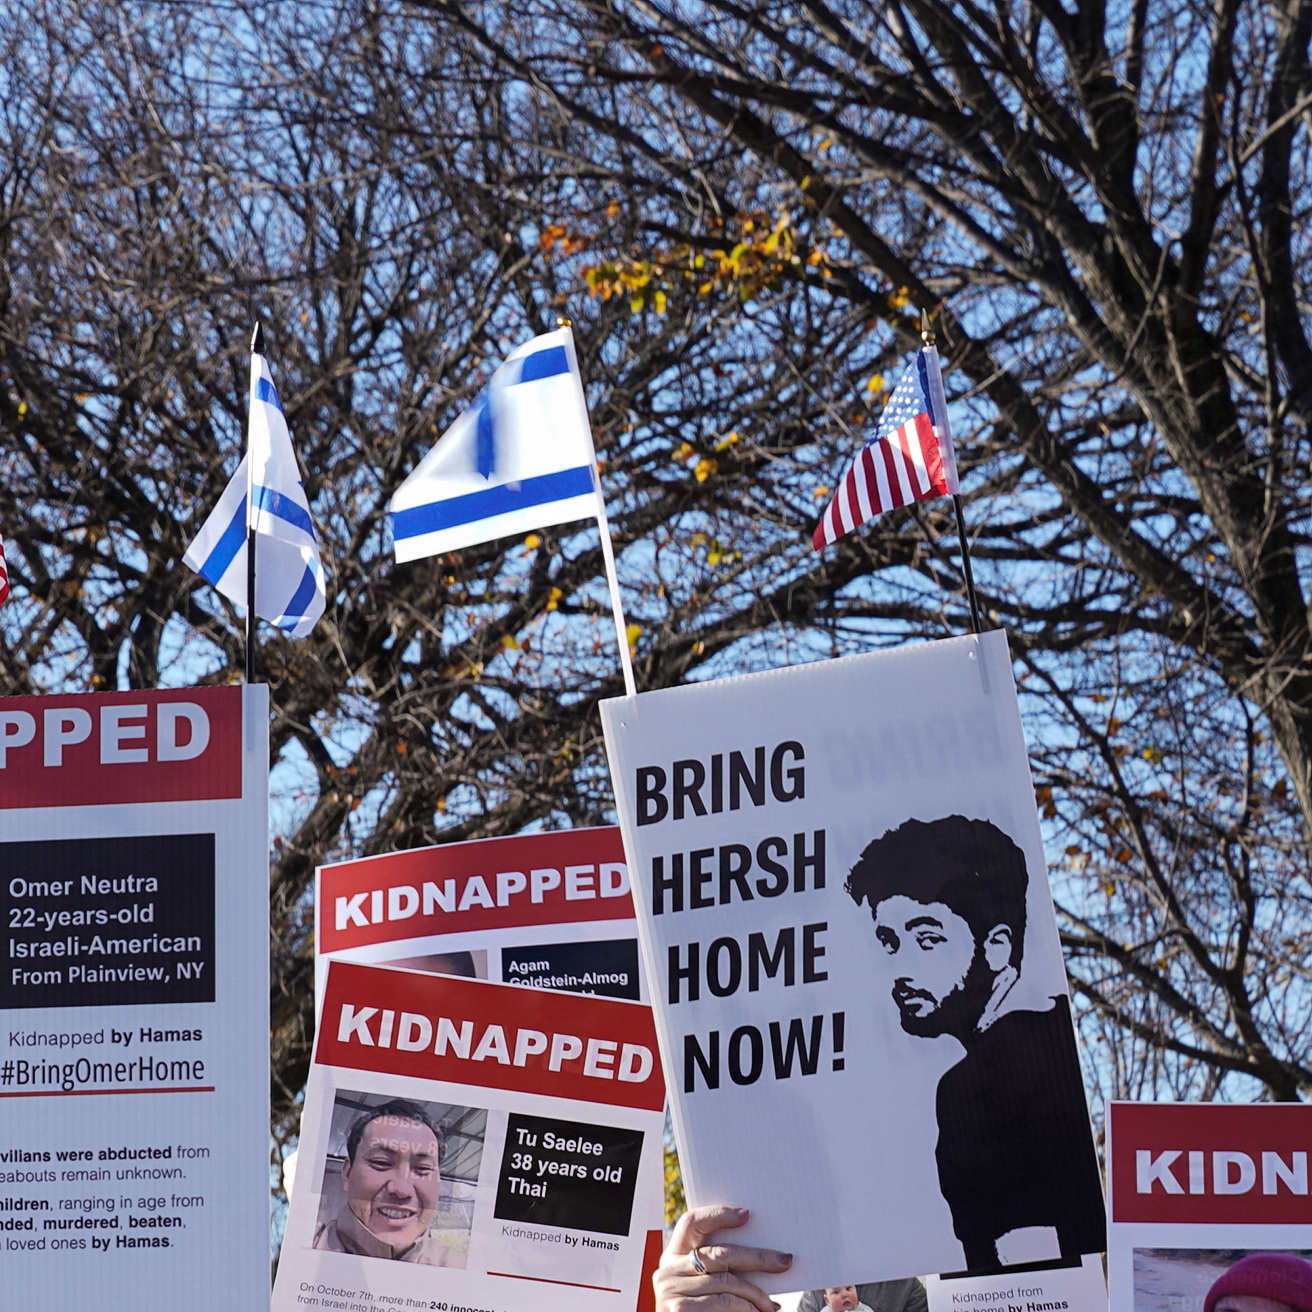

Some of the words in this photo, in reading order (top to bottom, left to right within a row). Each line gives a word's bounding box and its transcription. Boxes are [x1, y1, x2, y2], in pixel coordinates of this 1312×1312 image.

[636, 740, 805, 827] BRING
[652, 828, 826, 916] HERSH
[9, 878, 74, 898] Omer
[81, 874, 158, 895] Neutra
[335, 862, 631, 930] KIDNAPPED
[8, 903, 154, 932] 22-years-old
[9, 933, 201, 958] Israeli-American
[12, 968, 62, 986] From
[68, 963, 170, 984] Plainview,
[177, 961, 205, 980] NY
[508, 960, 550, 975] Agam
[668, 921, 829, 1005] HOME
[9, 1029, 104, 1049] Kidnapped
[111, 1028, 133, 1048] by
[140, 1027, 203, 1043] Hamas
[337, 1003, 654, 1083] KIDNAPPED
[683, 1011, 845, 1094] NOW!
[1, 1057, 205, 1091] #BringOmerHome
[55, 1150, 94, 1162] were
[98, 1145, 172, 1161] abducted
[177, 1145, 210, 1159] from
[516, 1128, 538, 1147] Tu
[542, 1132, 604, 1156] Saelee
[510, 1152, 533, 1171] 38
[536, 1159, 588, 1179] years
[592, 1165, 623, 1184] old
[508, 1176, 548, 1198] Thai
[502, 1226, 562, 1243] Kidnapped
[564, 1234, 579, 1248] by
[581, 1236, 620, 1251] Hamas
[952, 1288, 1015, 1303] Kidnapped
[1017, 1286, 1044, 1298] from
[1026, 1300, 1069, 1312] Hamas
